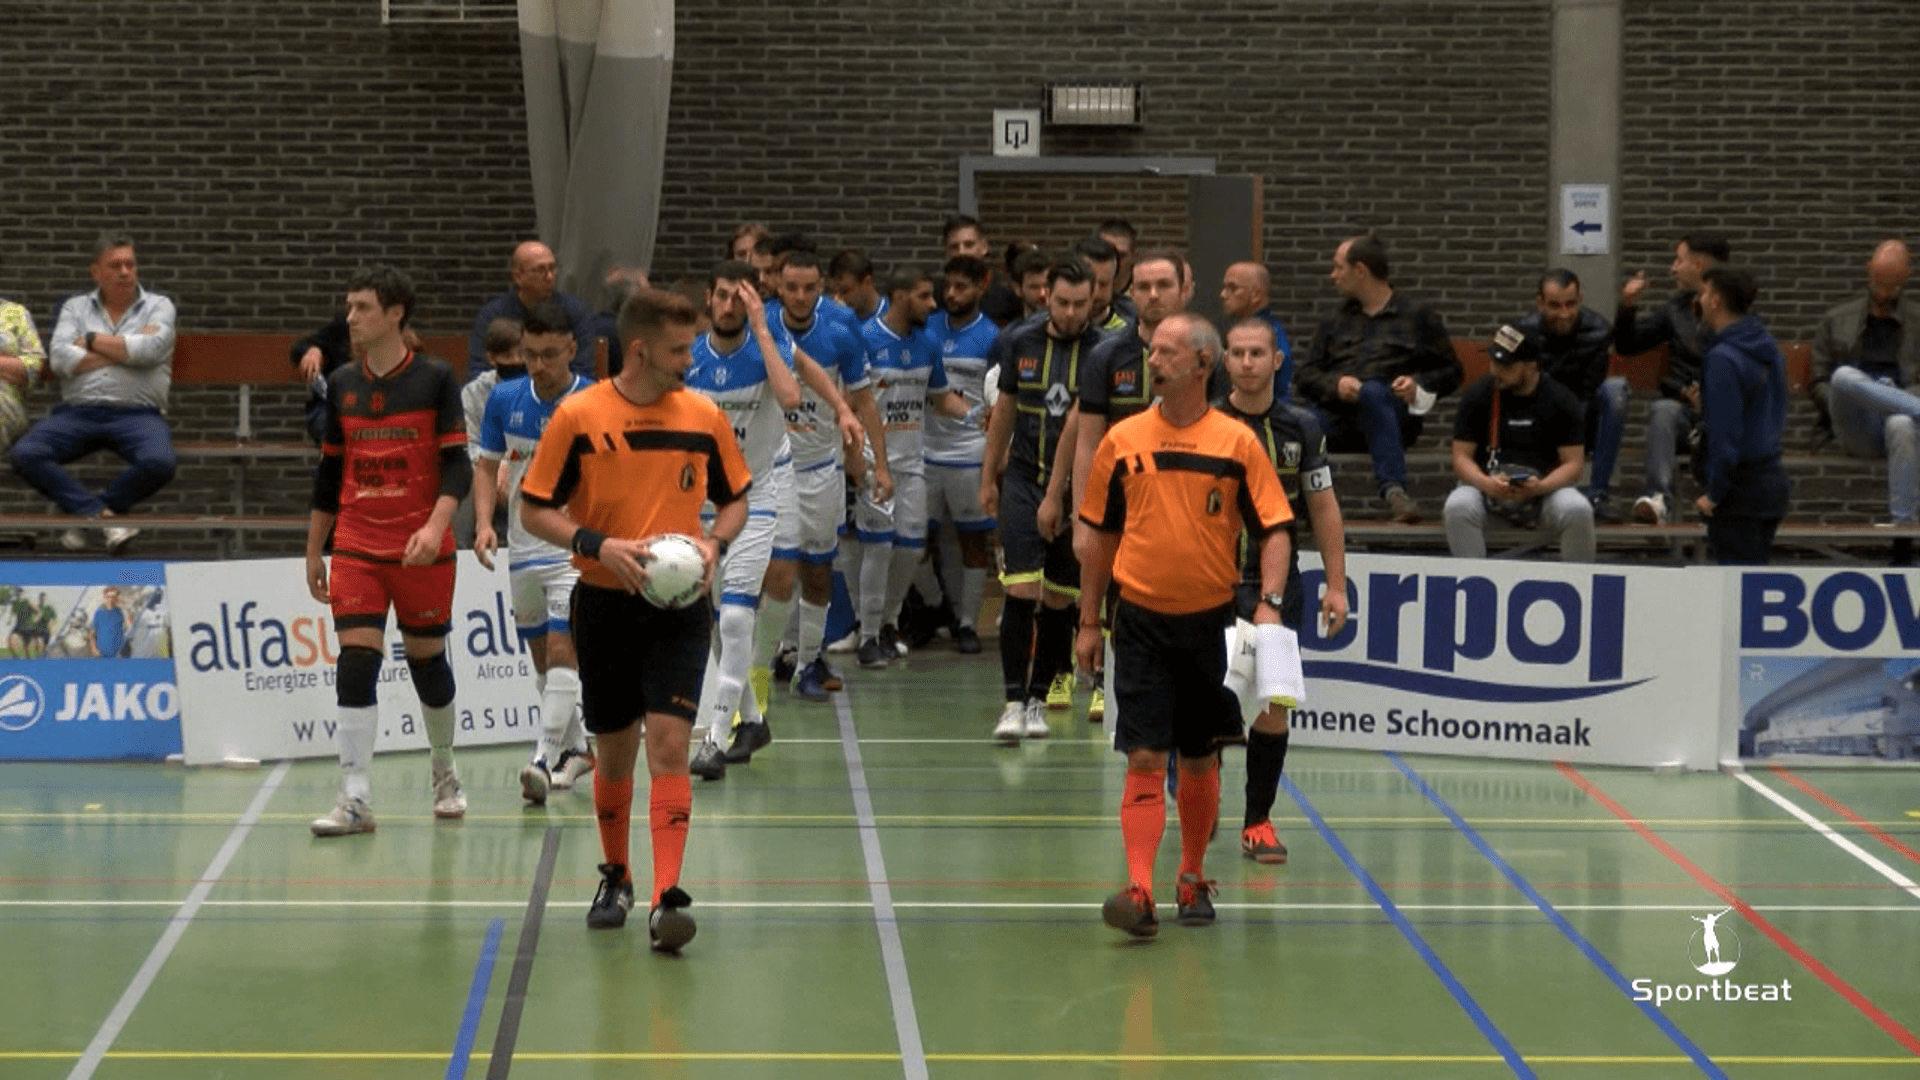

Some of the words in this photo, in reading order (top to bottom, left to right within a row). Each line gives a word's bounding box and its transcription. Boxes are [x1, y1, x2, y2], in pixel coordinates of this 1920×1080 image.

[1310, 472, 1323, 488] C
[1299, 568, 1627, 683] erpol
[1740, 571, 1920, 651] BOV
[189, 601, 338, 673] alfasu
[245, 671, 318, 694] Energize
[323, 668, 337, 688] th
[476, 661, 514, 680] Airco
[518, 660, 529, 677] &
[55, 681, 180, 722] JAKO
[1290, 708, 1377, 733] mene
[1386, 708, 1591, 747] Schoonmaak
